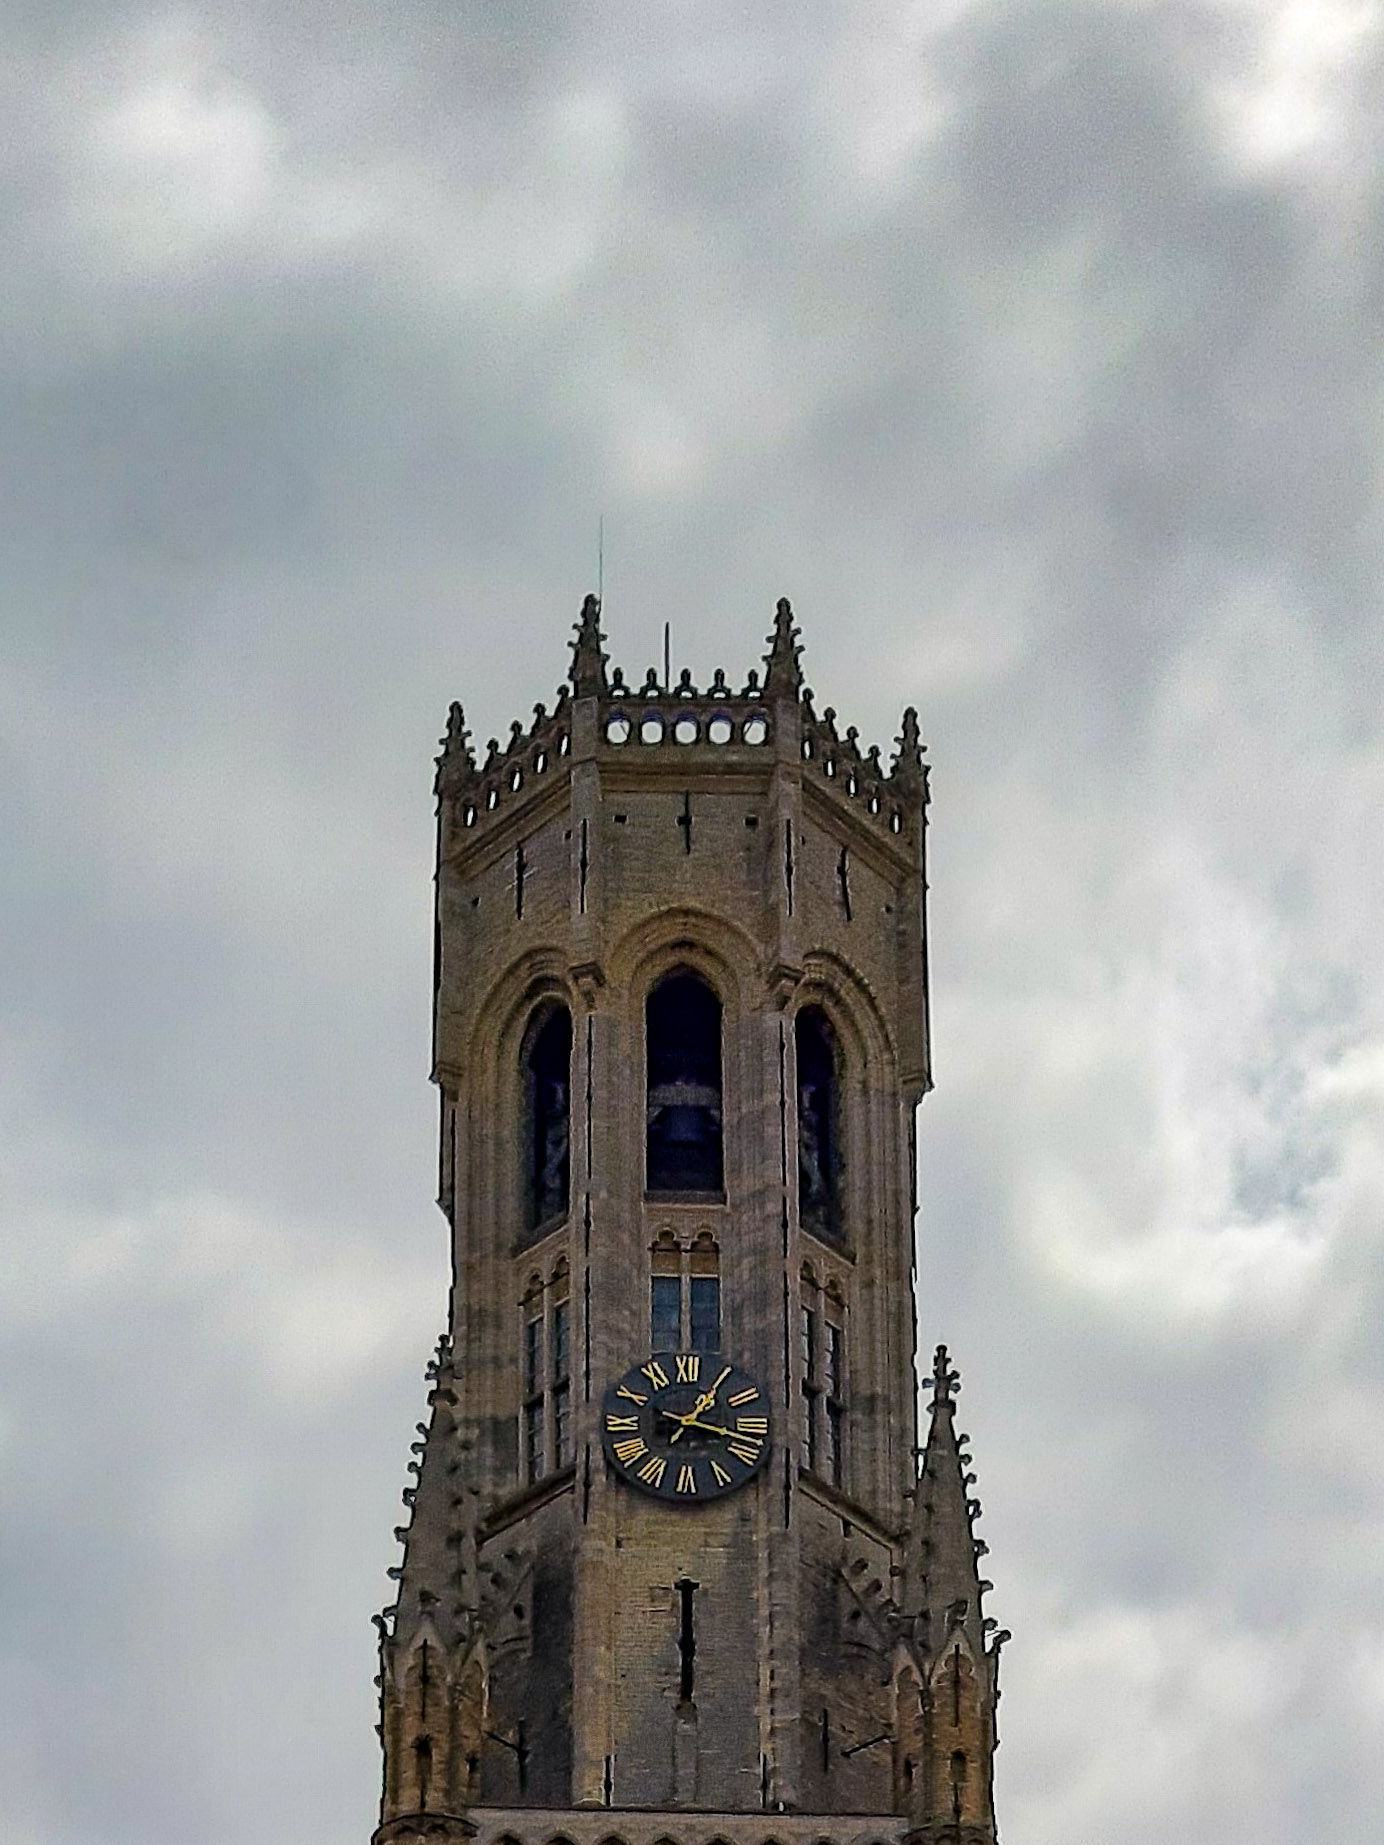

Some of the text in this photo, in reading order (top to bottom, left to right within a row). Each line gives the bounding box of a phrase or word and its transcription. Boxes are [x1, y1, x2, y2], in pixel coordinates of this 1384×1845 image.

[641, 1361, 670, 1391] XI
[676, 1355, 700, 1383] XII
[616, 1384, 649, 1407] X
[728, 1386, 759, 1407] II
[606, 1414, 639, 1431] IX
[737, 1417, 768, 1434] III
[709, 1460, 732, 1487] V
